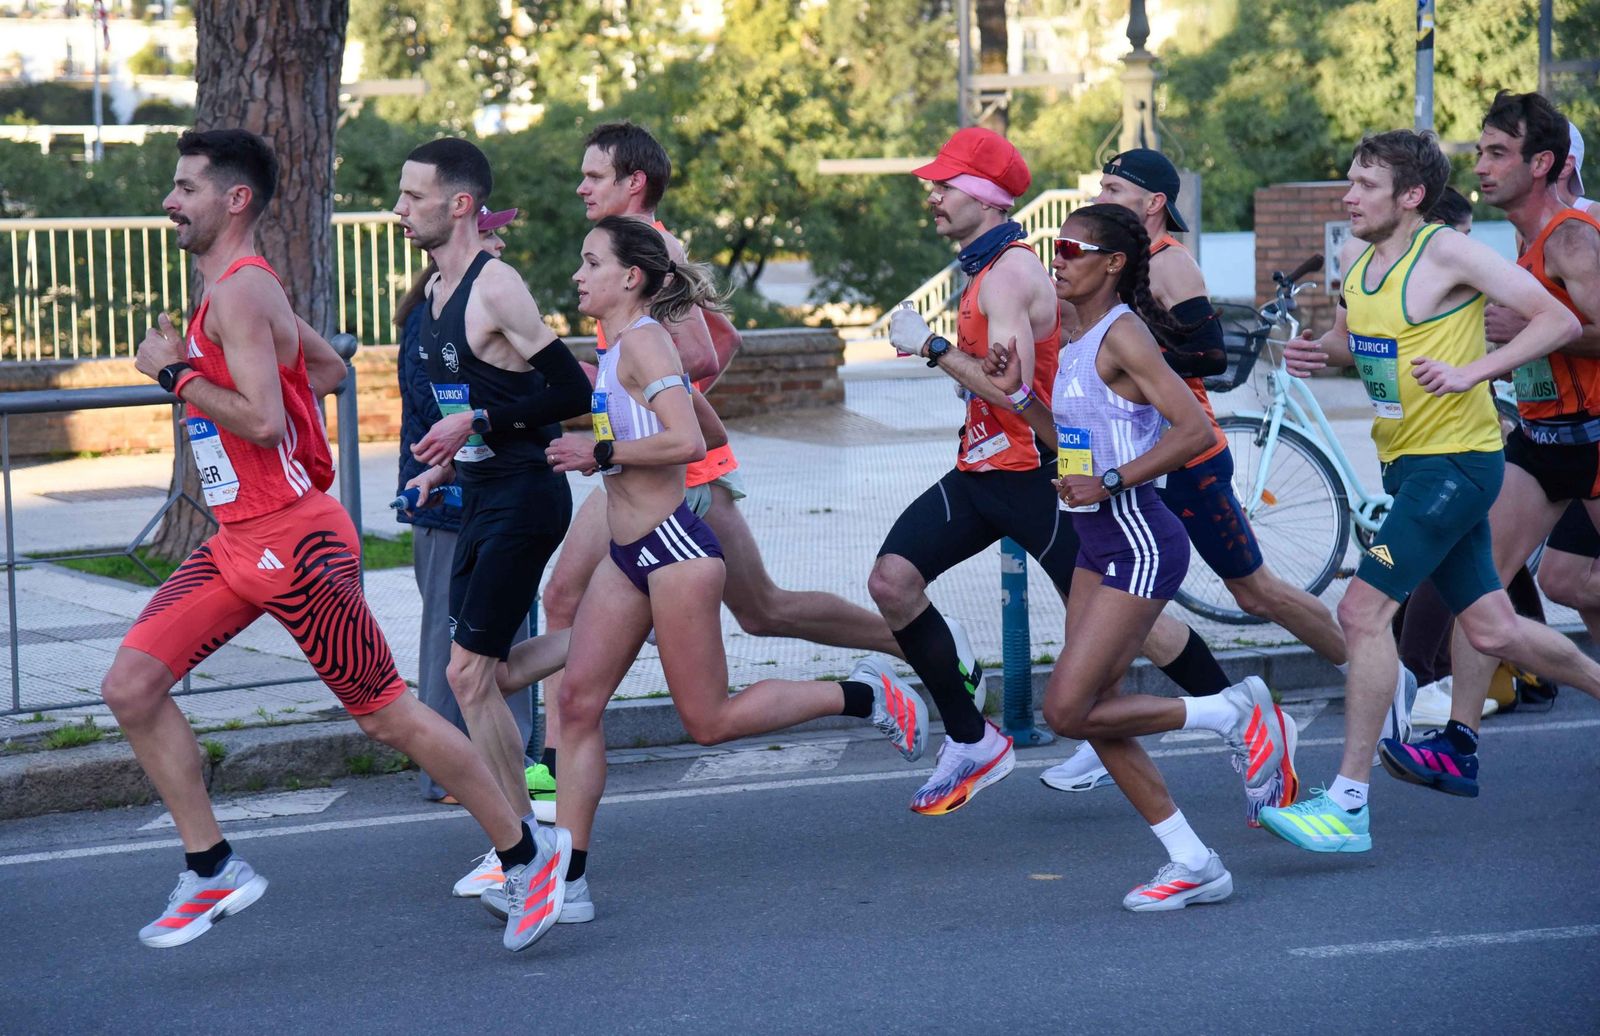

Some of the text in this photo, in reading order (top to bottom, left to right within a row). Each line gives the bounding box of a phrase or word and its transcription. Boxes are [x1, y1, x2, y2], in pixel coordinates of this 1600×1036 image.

[1357, 340, 1389, 353] ZURICH
[438, 390, 464, 400] ZURICH
[1531, 429, 1559, 445] MAX
